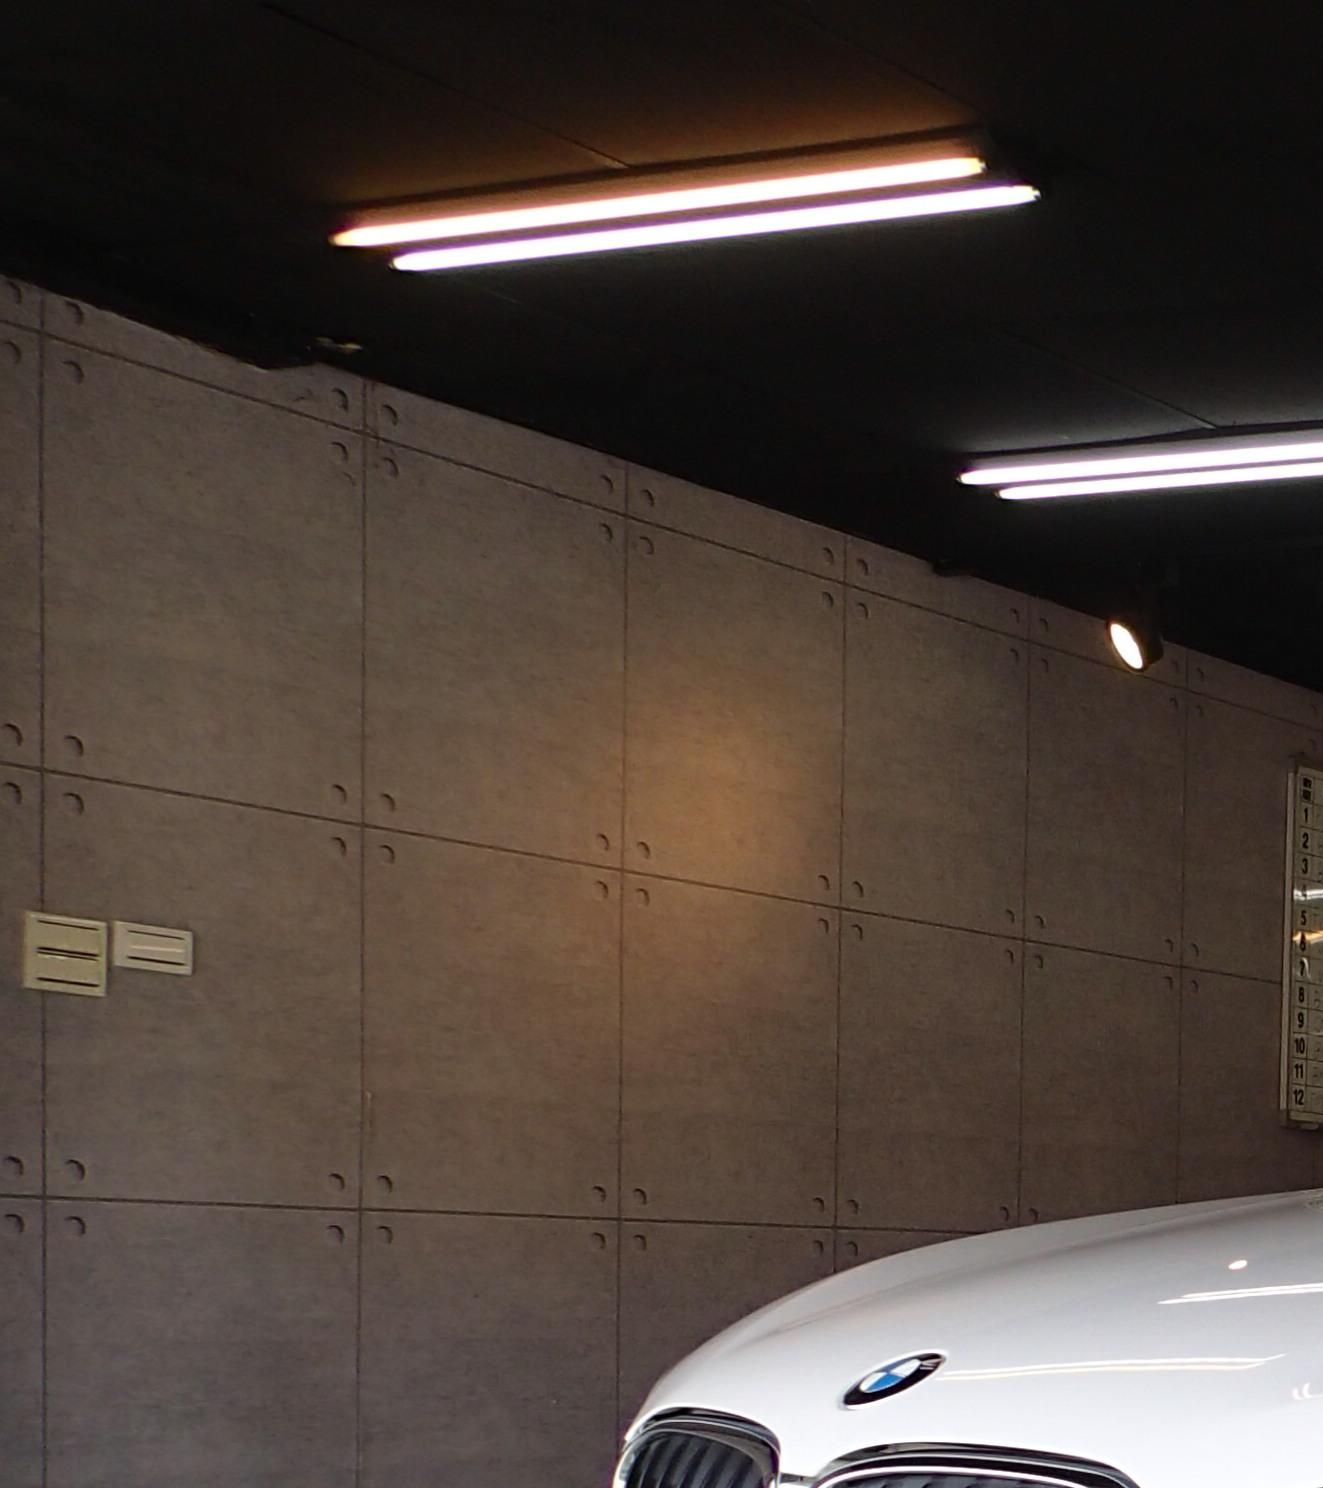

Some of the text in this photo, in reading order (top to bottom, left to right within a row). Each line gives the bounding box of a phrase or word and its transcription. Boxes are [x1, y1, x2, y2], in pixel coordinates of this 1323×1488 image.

[1303, 807, 1309, 824] 1
[1301, 832, 1309, 849] 2
[1301, 858, 1309, 875] 3
[1300, 909, 1307, 926] 5
[1298, 986, 1305, 1003] 8
[1297, 1011, 1305, 1029] 9
[1294, 1037, 1306, 1054] 10
[1294, 1063, 1304, 1080] 11
[1293, 1089, 1304, 1106] 12
